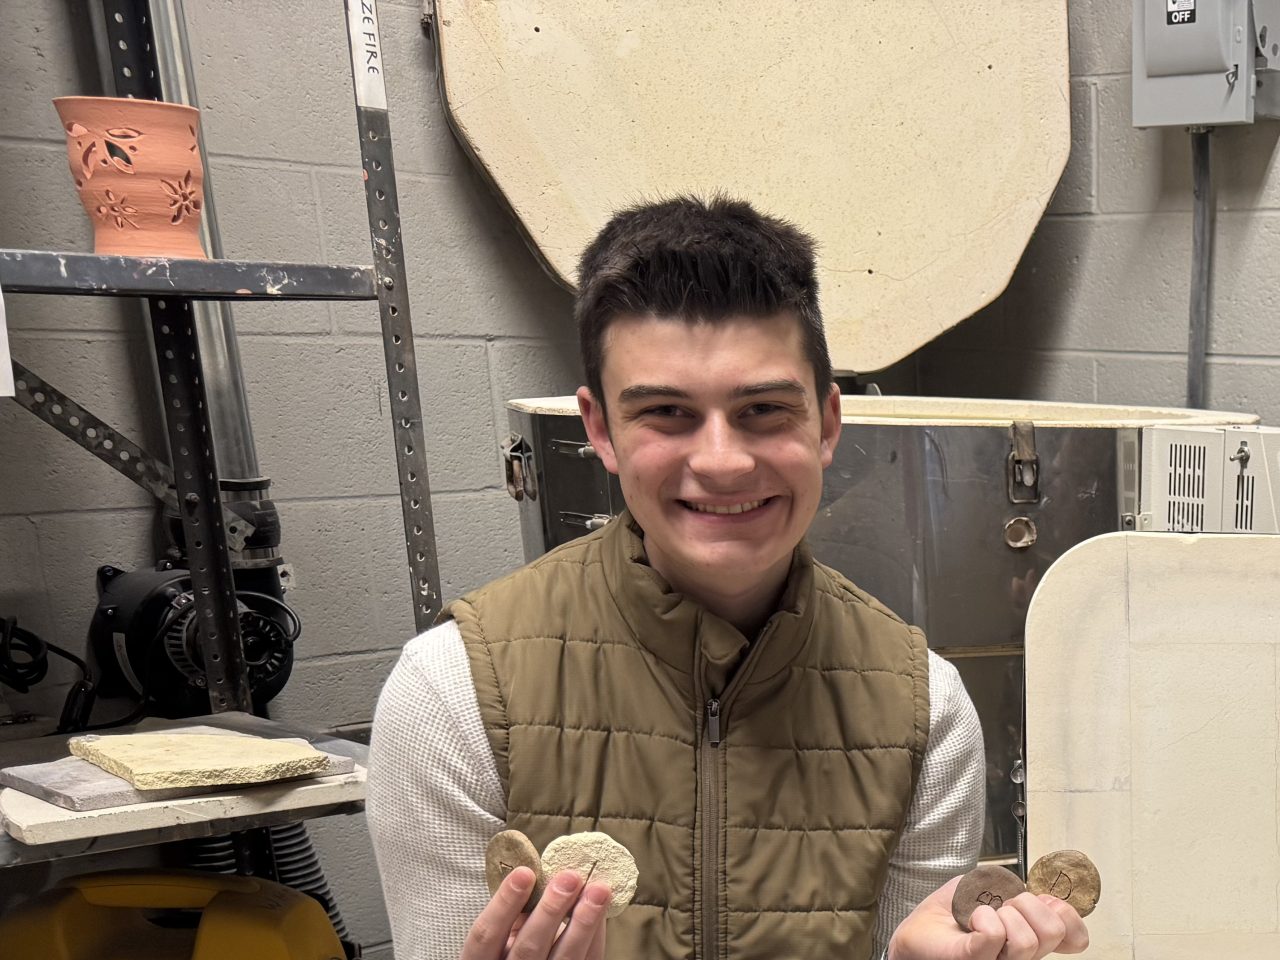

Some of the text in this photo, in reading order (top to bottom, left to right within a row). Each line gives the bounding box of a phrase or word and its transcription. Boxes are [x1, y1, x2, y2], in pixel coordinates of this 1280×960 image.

[1171, 11, 1191, 22] OFF
[361, 0, 379, 76] ZE FIRE
[1049, 870, 1073, 900] D
